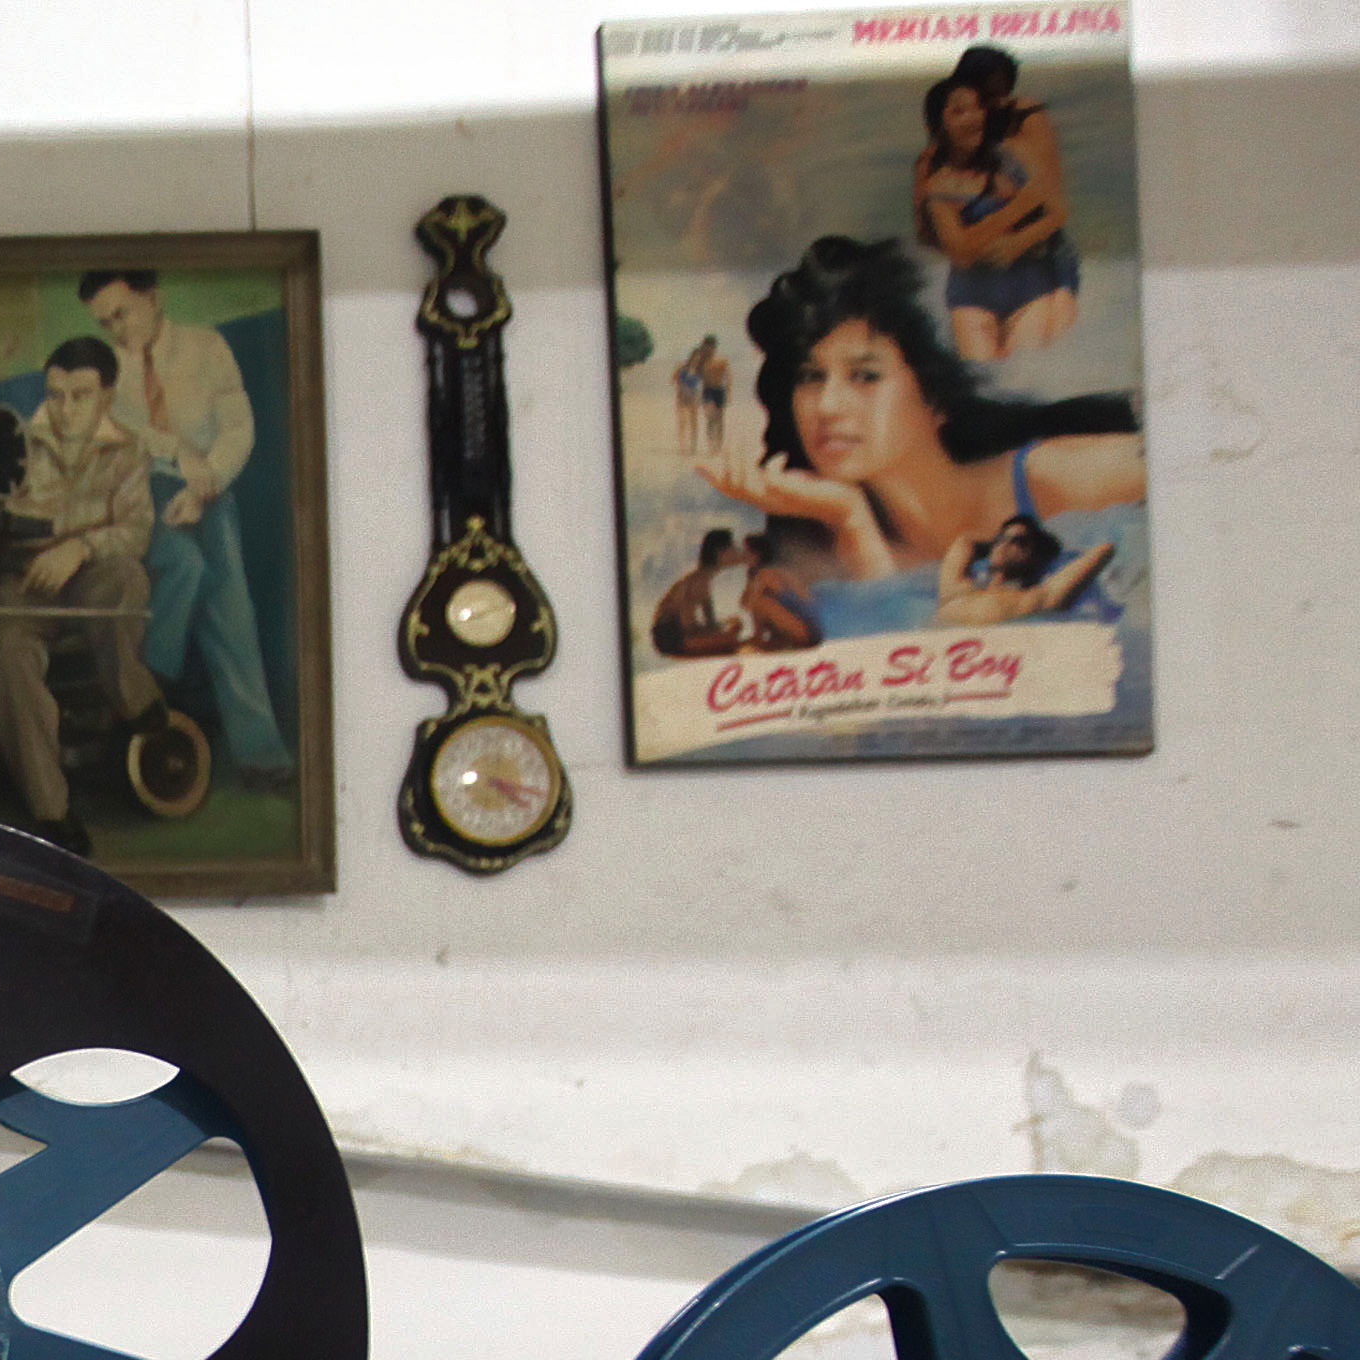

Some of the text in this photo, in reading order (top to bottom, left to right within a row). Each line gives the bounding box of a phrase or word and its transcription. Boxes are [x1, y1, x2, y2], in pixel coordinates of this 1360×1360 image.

[706, 659, 866, 713] Catatan
[880, 645, 938, 687] Si
[943, 638, 1024, 688] Boy
